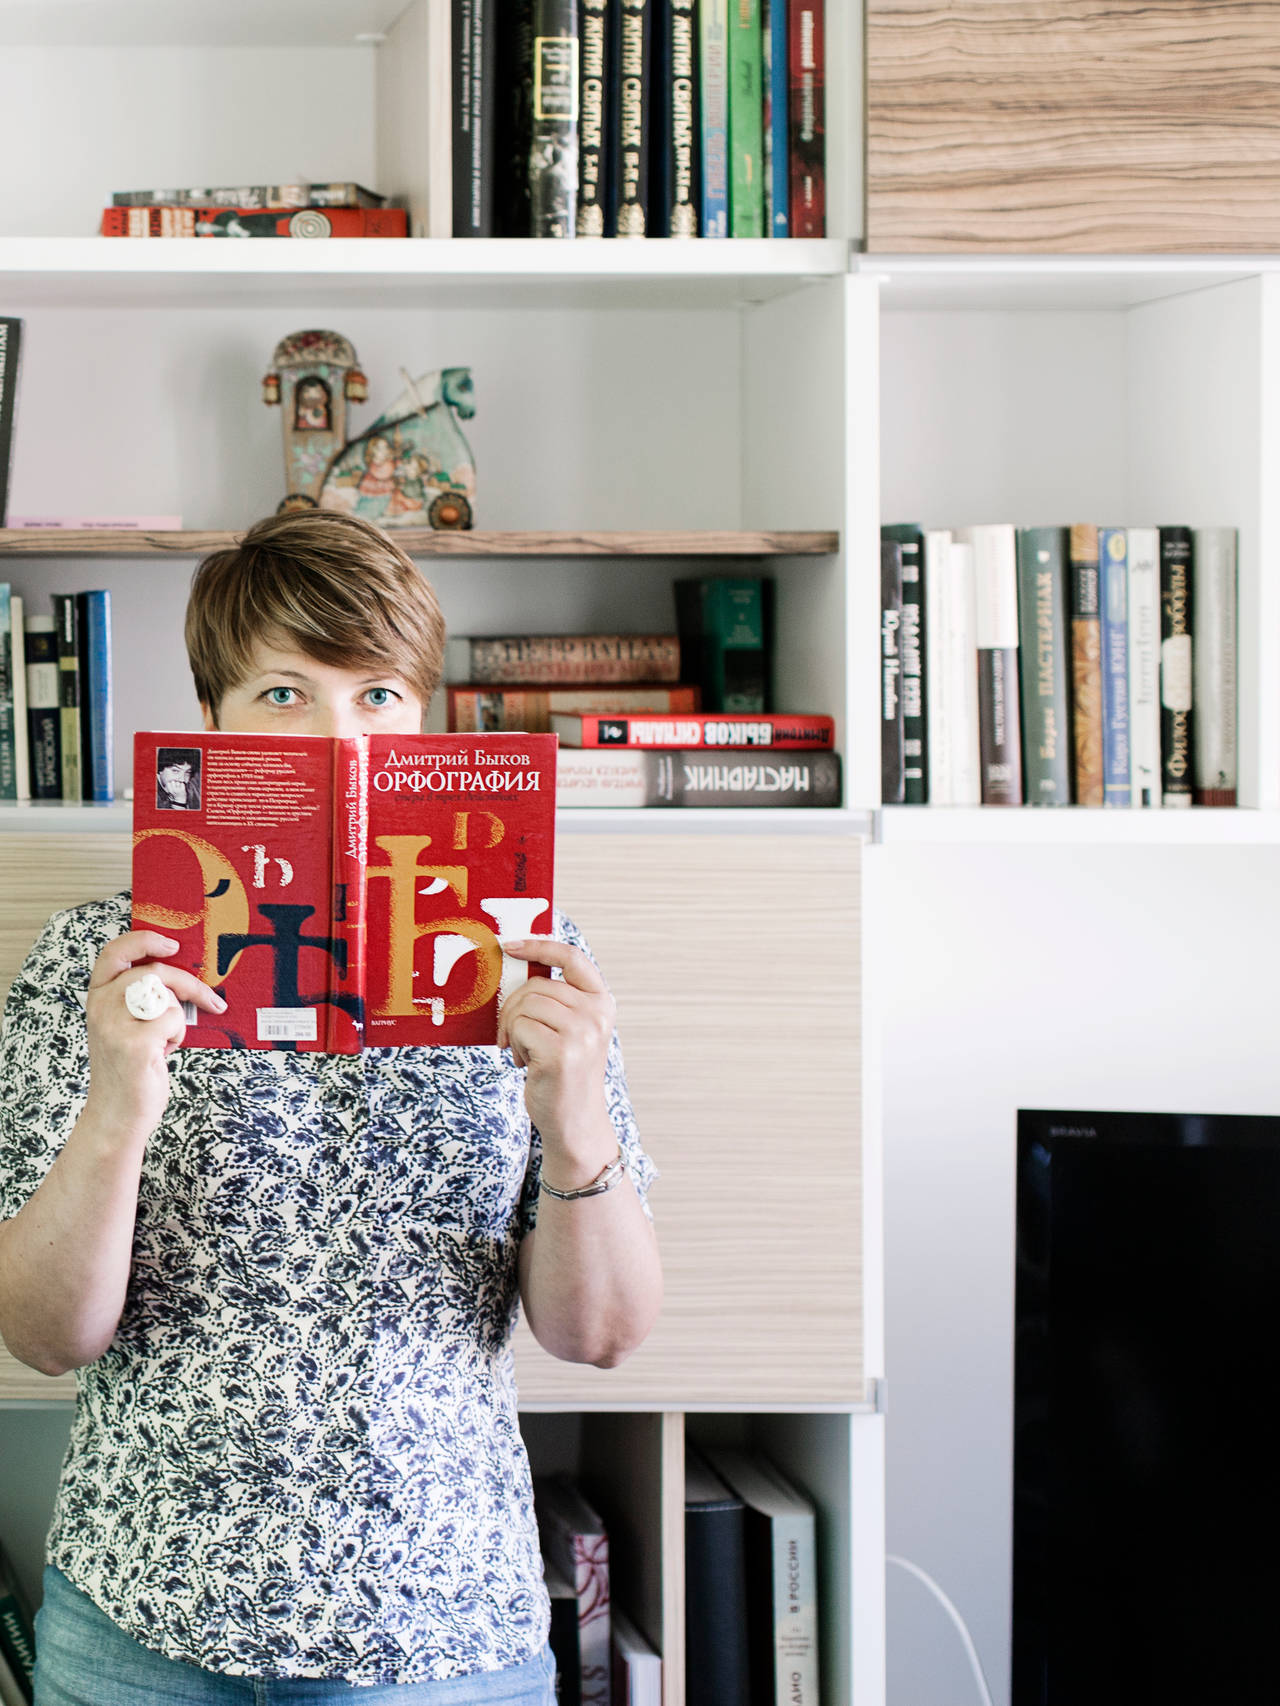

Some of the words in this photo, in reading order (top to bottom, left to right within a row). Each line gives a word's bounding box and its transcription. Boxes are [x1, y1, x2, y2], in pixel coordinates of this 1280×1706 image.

[583, 14, 604, 77] ЖИТИЯ
[623, 14, 643, 77] ЖИТИЯ
[672, 14, 692, 77] ЖИТИЯ
[582, 78, 603, 148] СВЯТЫХ
[622, 78, 642, 148] СВЯТЫХ
[671, 78, 692, 148] СВЯТЫХ
[1036, 572, 1055, 696] ПАСТЕРНАК
[385, 749, 468, 771] Дмитрий
[475, 749, 530, 766] Быков
[629, 721, 701, 745] СИГНАЛЫ
[704, 722, 774, 746] БЫКОВ
[774, 728, 830, 745] Дмитрий
[1041, 708, 1058, 760] Борис
[1111, 734, 1129, 775] Карл
[346, 759, 359, 797] Быков
[373, 770, 541, 793] ОРФОГРАФИЯ
[683, 765, 810, 792] НАСТАВНИК
[344, 801, 360, 860] Дмитрий
[787, 1540, 802, 1601] РОССИИ
